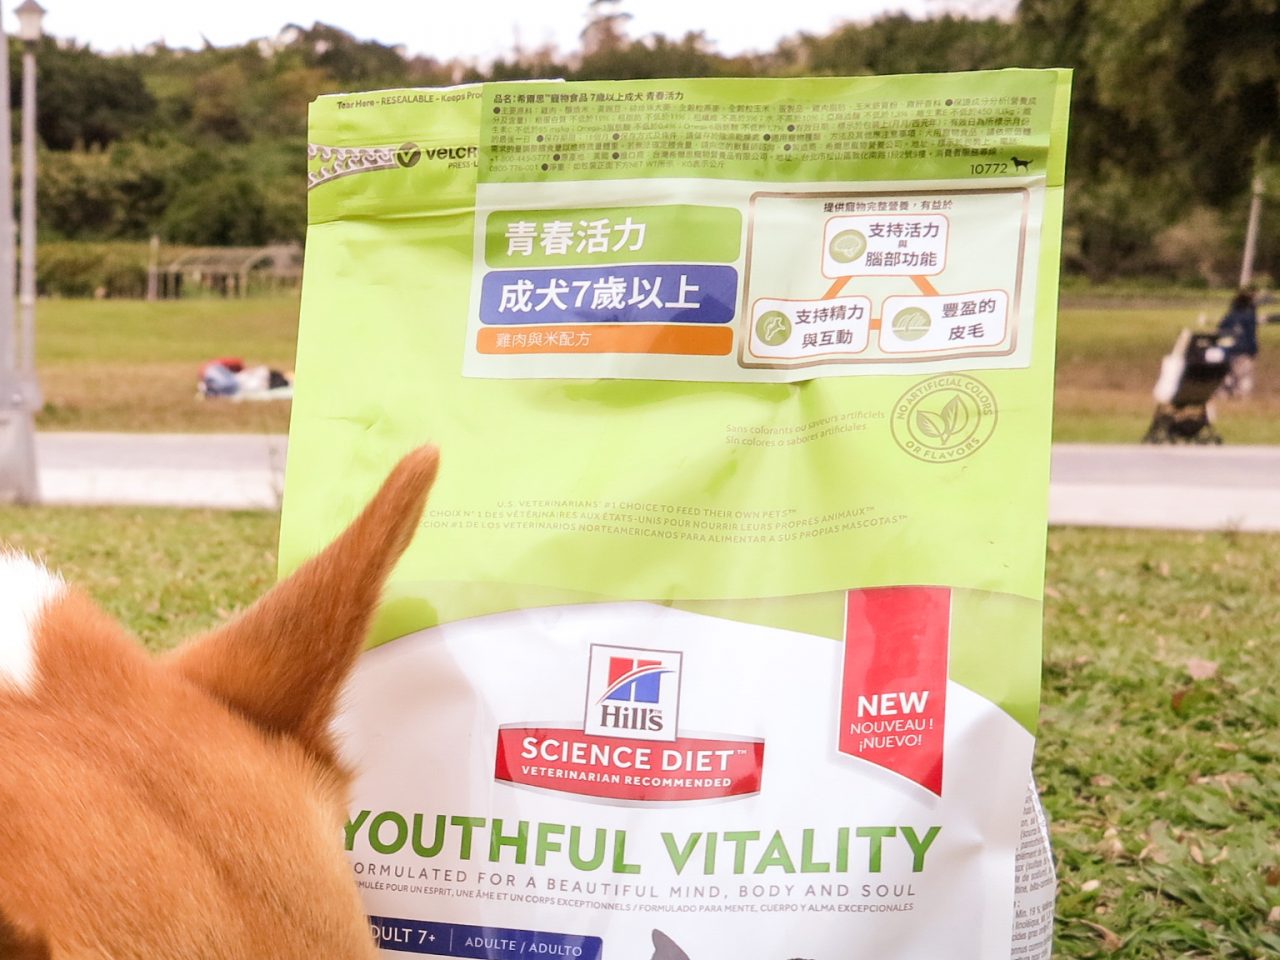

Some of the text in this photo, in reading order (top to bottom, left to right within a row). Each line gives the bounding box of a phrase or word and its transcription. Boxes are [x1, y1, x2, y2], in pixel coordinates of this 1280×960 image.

[381, 95, 434, 105] RESEALABLE
[971, 163, 1007, 174] 10772
[504, 216, 647, 256] 青春活力
[868, 222, 939, 238] 支持活力
[865, 251, 937, 267] 腦部功能
[498, 275, 701, 313] 成犬7歲以上
[795, 304, 864, 325] 支持精力
[942, 298, 996, 319] 豐盈的
[495, 331, 592, 348] 雞肉與米配方
[802, 329, 853, 348] 與互動
[948, 323, 984, 341] 皮毛
[896, 378, 993, 420] NO ARTIFICIAL COLORS
[905, 437, 980, 459] OR FLAVORS
[620, 501, 658, 512] CHOICE
[661, 504, 674, 513] TO
[676, 506, 701, 516] FEED
[703, 508, 732, 518] THEIR
[735, 511, 759, 519] OWN
[485, 511, 504, 519] DES
[664, 518, 690, 528] POUR
[693, 521, 737, 531] NOURRIR
[741, 521, 775, 531] LEURS
[775, 517, 820, 530] PROPRES
[579, 524, 678, 540] NORTEAMERICANOS
[681, 532, 706, 542] PARA
[708, 535, 766, 544] ALIMENTAR
[778, 533, 798, 542] SUS
[799, 525, 840, 539] PROPIAS
[857, 690, 930, 718] NEW
[850, 718, 926, 735] NOUVEAU
[859, 734, 922, 752] ¡NUEVO!
[520, 737, 651, 770] SCIENCE
[521, 765, 732, 788] VETERINARIAN RECOMMENDED
[343, 809, 943, 876] YOUTHFUL VITALITY
[354, 862, 916, 899] ORMULATED FOR A BEAUTIFUL MIND, BODY AND SOUL
[386, 883, 408, 893] POUR
[410, 885, 422, 893] UN
[424, 887, 454, 897] ESPRIT,
[456, 889, 473, 898] UNE
[476, 889, 495, 900] ÂME
[497, 892, 508, 900] ET
[510, 893, 523, 902] UN
[525, 895, 555, 905] CORPS
[557, 898, 631, 911] EXCEPTIONNELS
[639, 904, 697, 913] FORMULADO
[699, 904, 721, 913] PARA
[760, 903, 798, 912] CUERPO
[800, 904, 807, 912] Y
[808, 904, 835, 912] ALMA
[837, 902, 913, 913] EXCEPCIONALES
[371, 925, 436, 944] DULT 7+
[465, 937, 582, 957] ADULTE ADULTO
